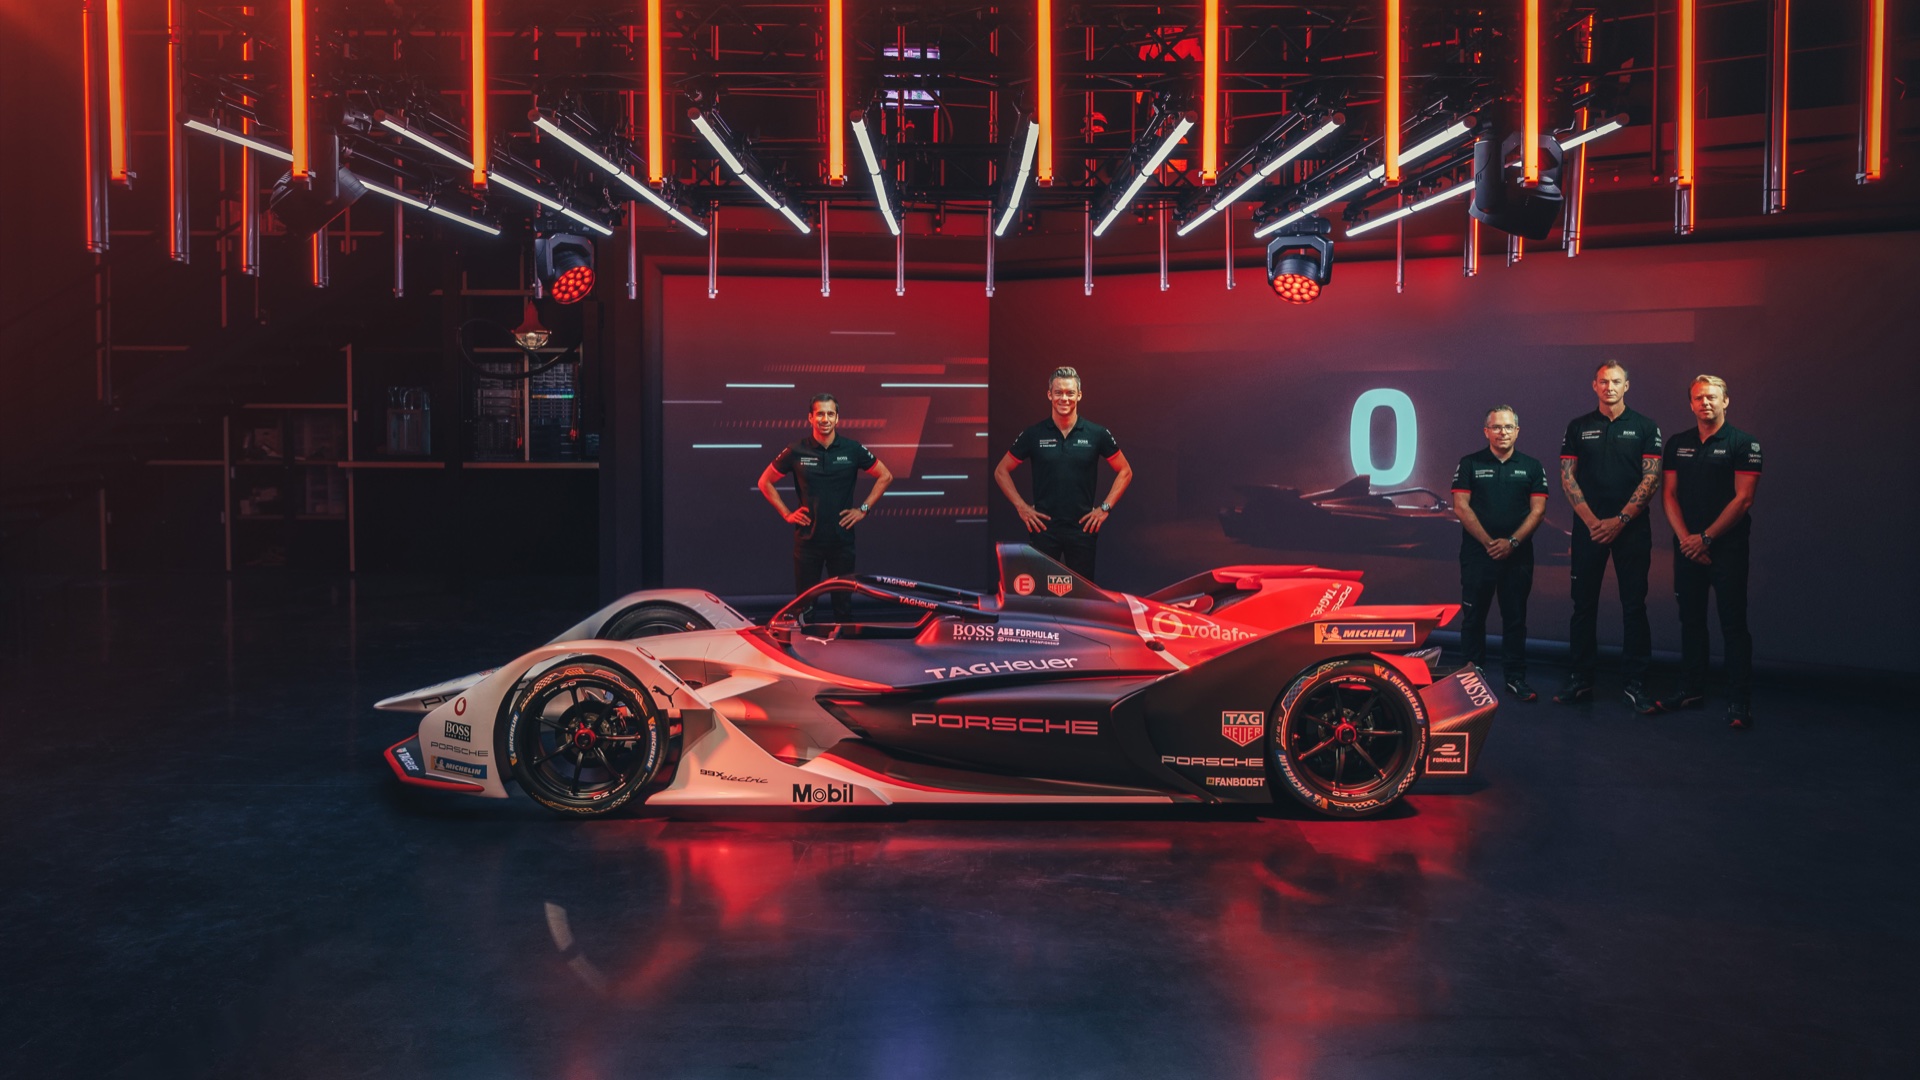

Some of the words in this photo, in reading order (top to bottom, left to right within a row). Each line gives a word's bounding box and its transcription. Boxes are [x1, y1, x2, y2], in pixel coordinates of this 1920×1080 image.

[1350, 388, 1418, 486] 0
[1049, 576, 1070, 584] TAG
[953, 624, 995, 637] BOSS
[997, 627, 1014, 636] ABB
[1342, 629, 1406, 638] MICHELIN
[924, 657, 1078, 680] TAGHeuer
[1456, 671, 1495, 707] ANSYS
[1389, 675, 1424, 720] MICHELIN
[911, 713, 1099, 735] PORSCHE
[1225, 713, 1260, 725] TAG
[446, 721, 470, 737] BOSS
[508, 714, 519, 752] MICHELIN
[1224, 727, 1261, 744] HEUER
[430, 741, 489, 757] PORSCHE
[445, 763, 482, 775] MICHELIN
[1161, 755, 1264, 767] PORSCHE
[700, 768, 723, 777] 99X
[721, 775, 769, 784] electric
[1214, 778, 1265, 786] FANBOOST
[1278, 754, 1313, 798] MICHELIN
[792, 783, 854, 803] Mobil
